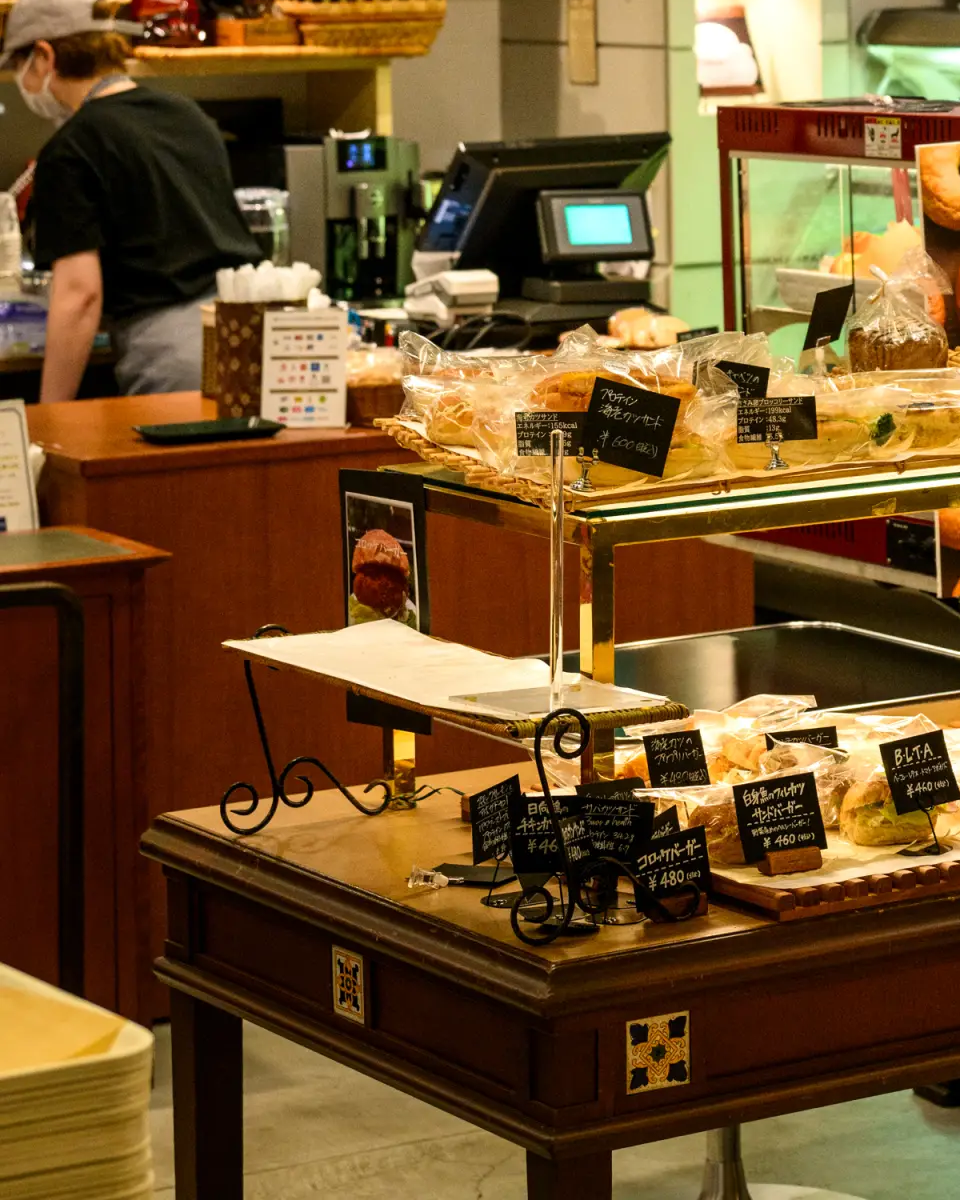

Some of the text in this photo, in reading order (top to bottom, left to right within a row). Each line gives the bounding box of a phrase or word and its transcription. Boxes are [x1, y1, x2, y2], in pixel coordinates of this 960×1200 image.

[752, 800, 804, 823] サンドバーガー
[637, 838, 702, 871] コロッケバーガー
